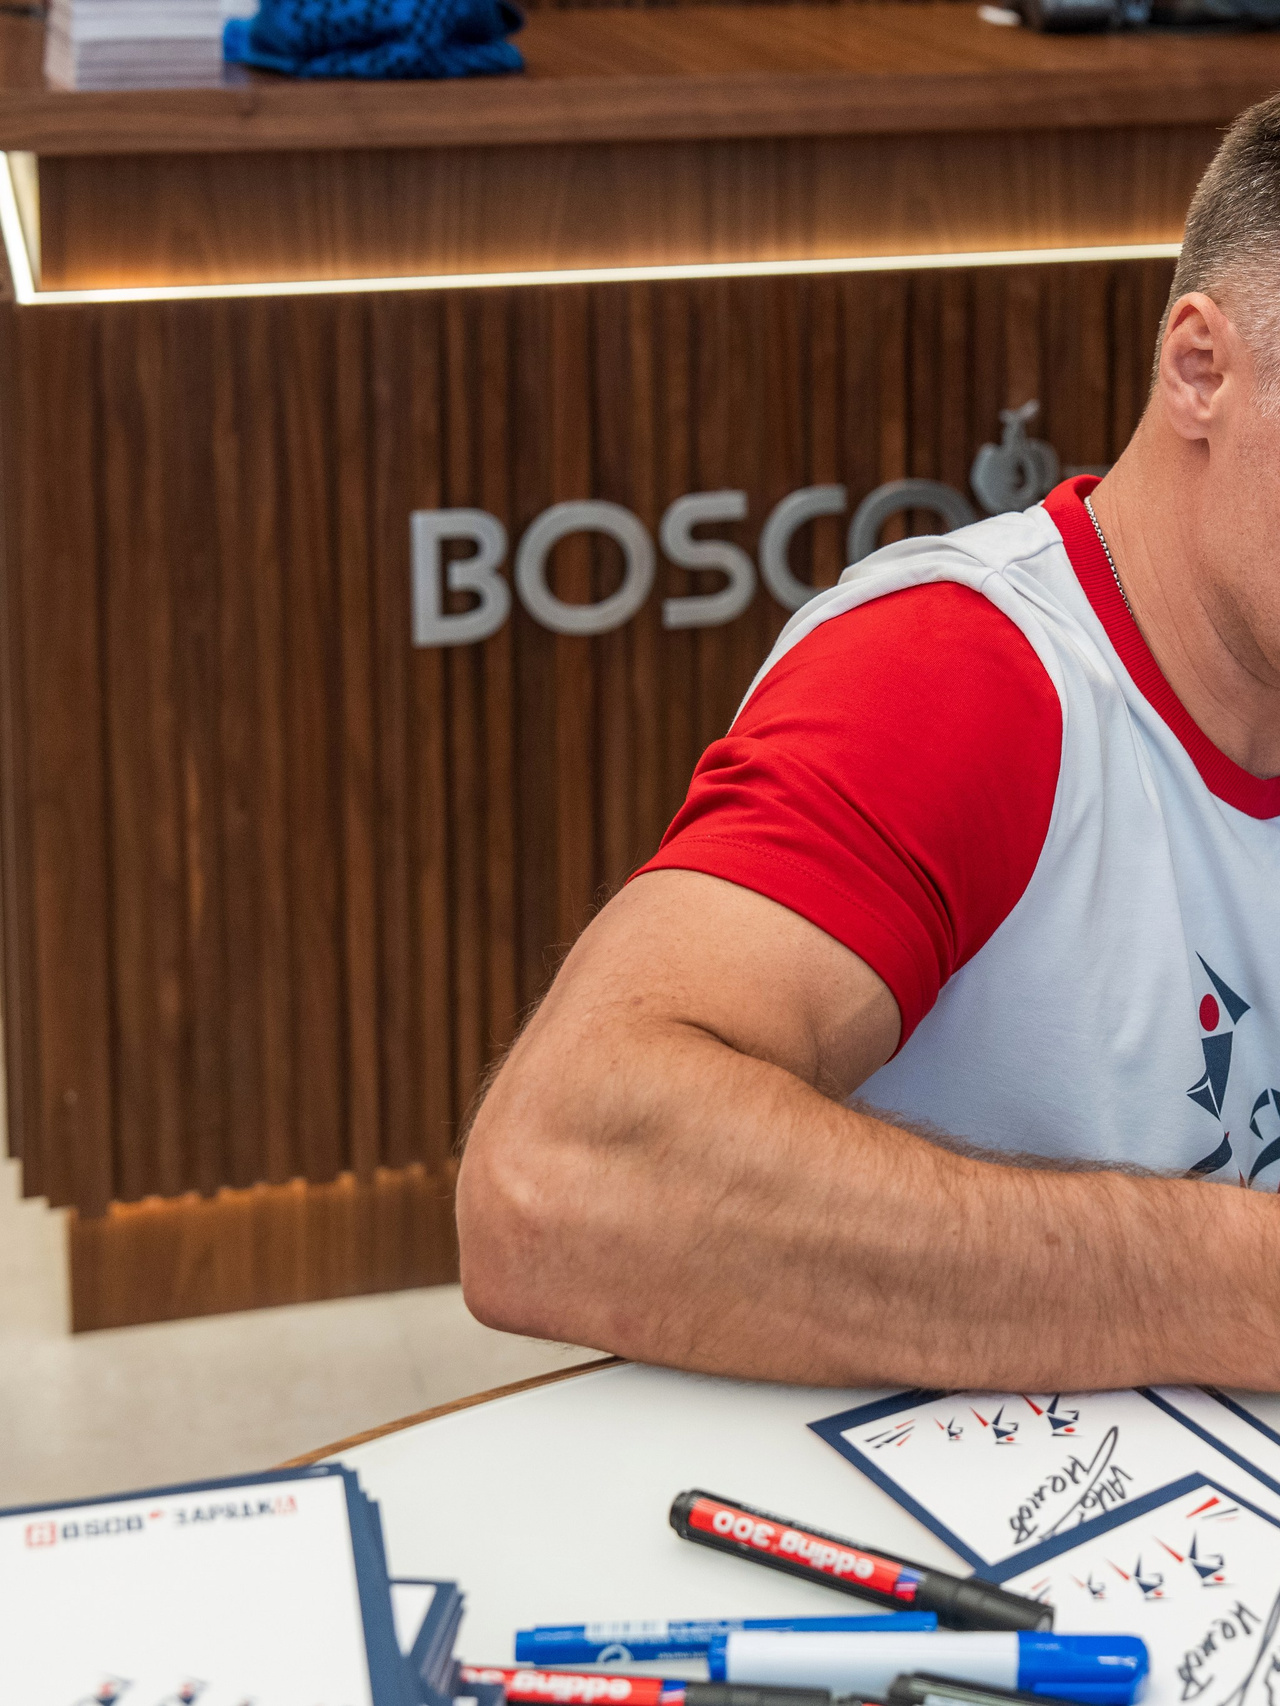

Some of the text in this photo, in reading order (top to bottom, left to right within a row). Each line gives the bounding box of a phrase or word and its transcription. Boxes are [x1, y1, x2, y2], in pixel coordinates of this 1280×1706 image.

[712, 1510, 775, 1547] 300
[779, 1530, 875, 1579] edding
[511, 1669, 633, 1701] edding
